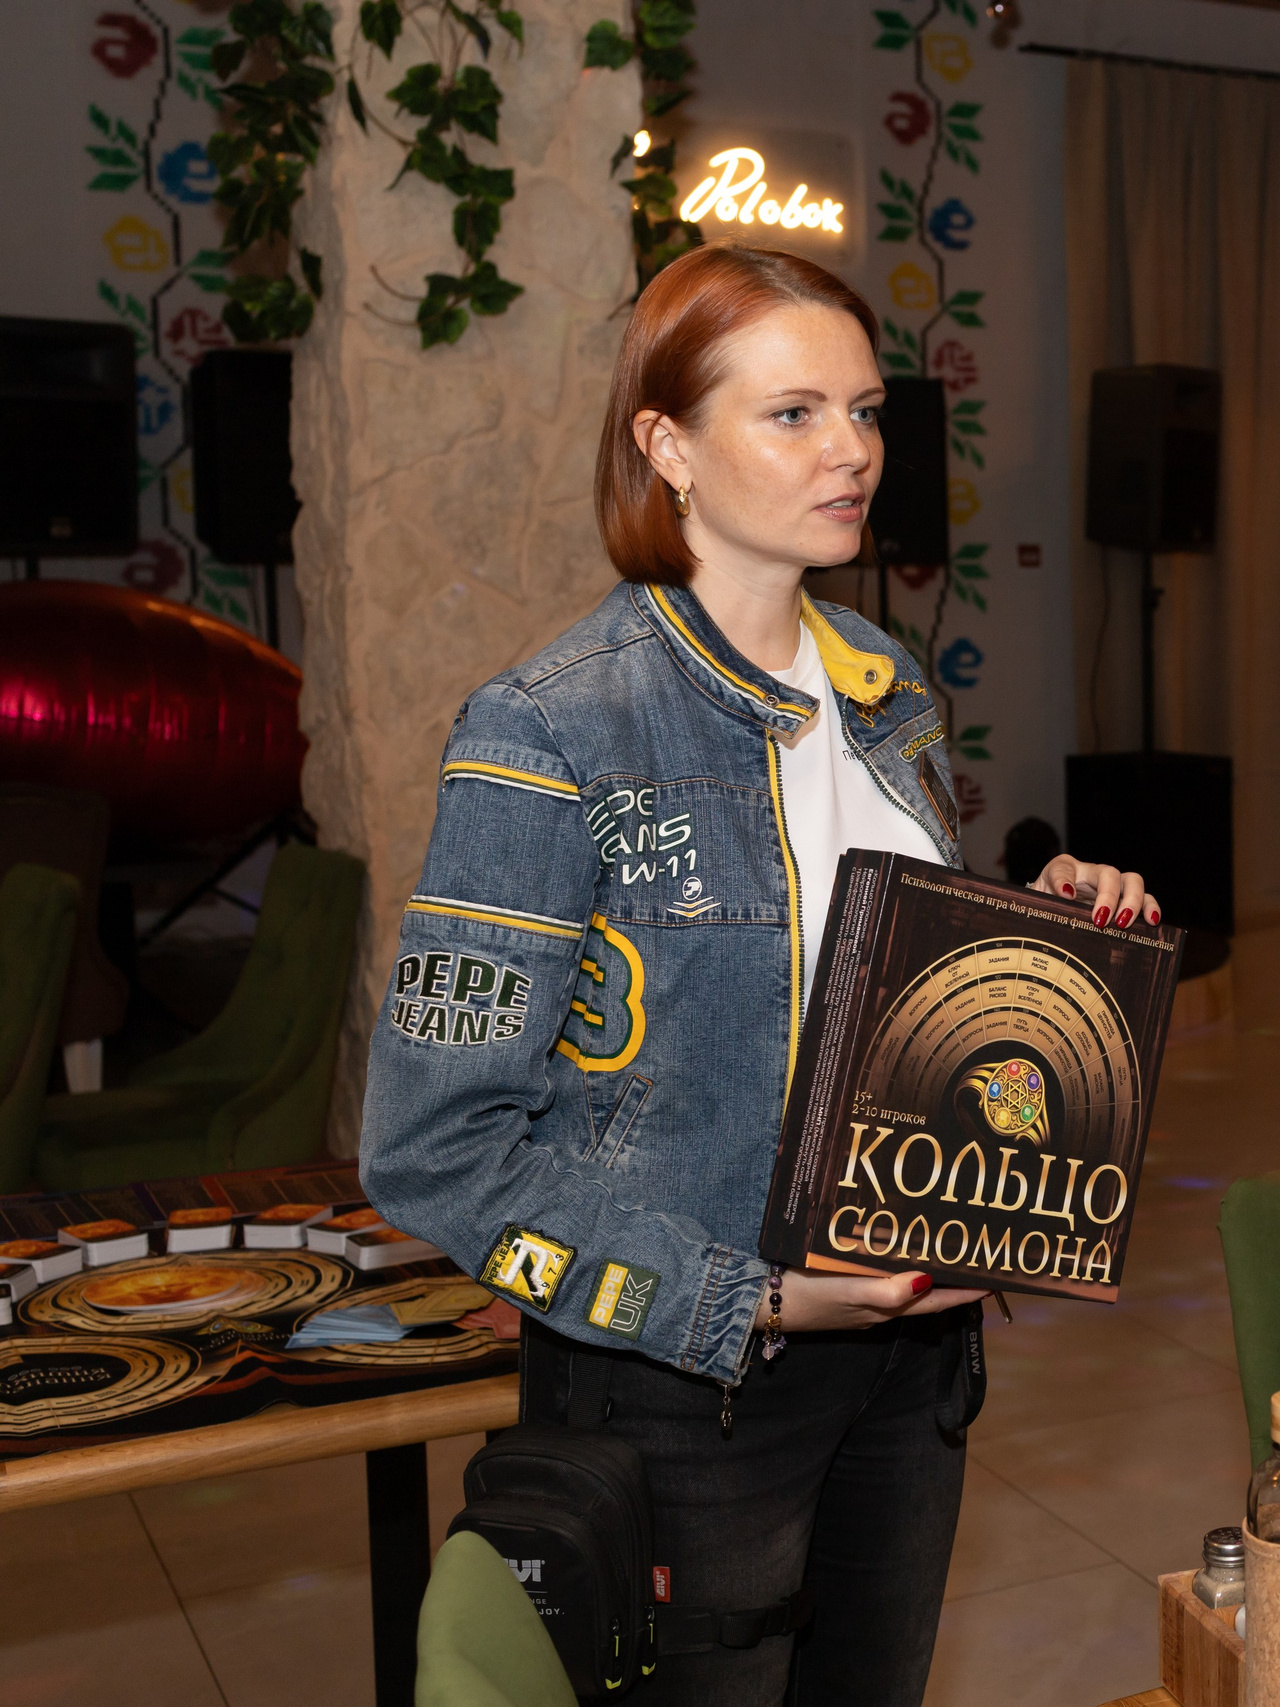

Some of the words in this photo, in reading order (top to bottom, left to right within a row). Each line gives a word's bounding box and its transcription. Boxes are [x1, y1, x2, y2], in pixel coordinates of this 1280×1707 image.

[861, 868, 873, 904] Евгенией
[842, 868, 861, 937] трансформировать
[900, 872, 984, 904] Психологическая
[987, 896, 1007, 910] игра
[1010, 900, 1026, 915] для
[1027, 907, 1068, 925] развития
[1129, 931, 1175, 952] мышления
[843, 938, 853, 960] Всего
[841, 961, 848, 969] за
[848, 950, 862, 993] настольная
[948, 964, 960, 973] КЛЮЧ
[1031, 963, 1047, 971] РИСКОВ
[1033, 957, 1049, 965] БАЛАНС
[396, 951, 532, 1012] PEPE
[837, 970, 846, 987] одну
[945, 971, 970, 988] ВСЕЛЕННОЙ
[1069, 978, 1087, 995] ВОПРОСЫ
[834, 989, 842, 1006] игру
[844, 994, 852, 1011] игра
[909, 995, 927, 1016] ВОПРОСЫ
[955, 998, 975, 1011] ЗАДАНИЯ
[1018, 995, 1042, 1006] ВСЕЛЕННОЙ
[390, 999, 526, 1045] JEANS
[823, 992, 835, 1030] выстроить
[831, 1007, 838, 1016] ты
[1053, 1005, 1071, 1021] ВОПРОСЫ
[825, 1017, 836, 1047] можешь
[836, 1018, 847, 1051] глубокая
[926, 1019, 944, 1040] ВОПРОСЫ
[962, 1027, 983, 1043] ВОПРОСЫ
[987, 1021, 1007, 1029] ЗАДАНИЯ
[1013, 1024, 1029, 1032] ТВОРЦА
[1037, 1028, 1054, 1045] ВОПРОСЫ
[814, 1031, 827, 1070] стратегию
[824, 1045, 836, 1077] автором
[818, 1048, 830, 1082] осознать
[814, 1083, 822, 1100] свои
[818, 1078, 829, 1105] метода
[822, 1052, 840, 1116] психологическая
[802, 1071, 819, 1128] материального
[855, 1090, 873, 1102] 15+
[852, 1103, 878, 1116] 2-10
[880, 1109, 926, 1126] игроков
[801, 1135, 812, 1165] вернуть
[797, 1166, 805, 1184] силу
[806, 1154, 819, 1194] созданная
[837, 1121, 1129, 1231] КОЛЬЦО
[827, 1204, 1113, 1284] СОЛОМОНА
[594, 1267, 624, 1325] PEPE
[610, 1274, 654, 1333] UK
[969, 1331, 981, 1375] BMW
[538, 1607, 565, 1616] JOY.
